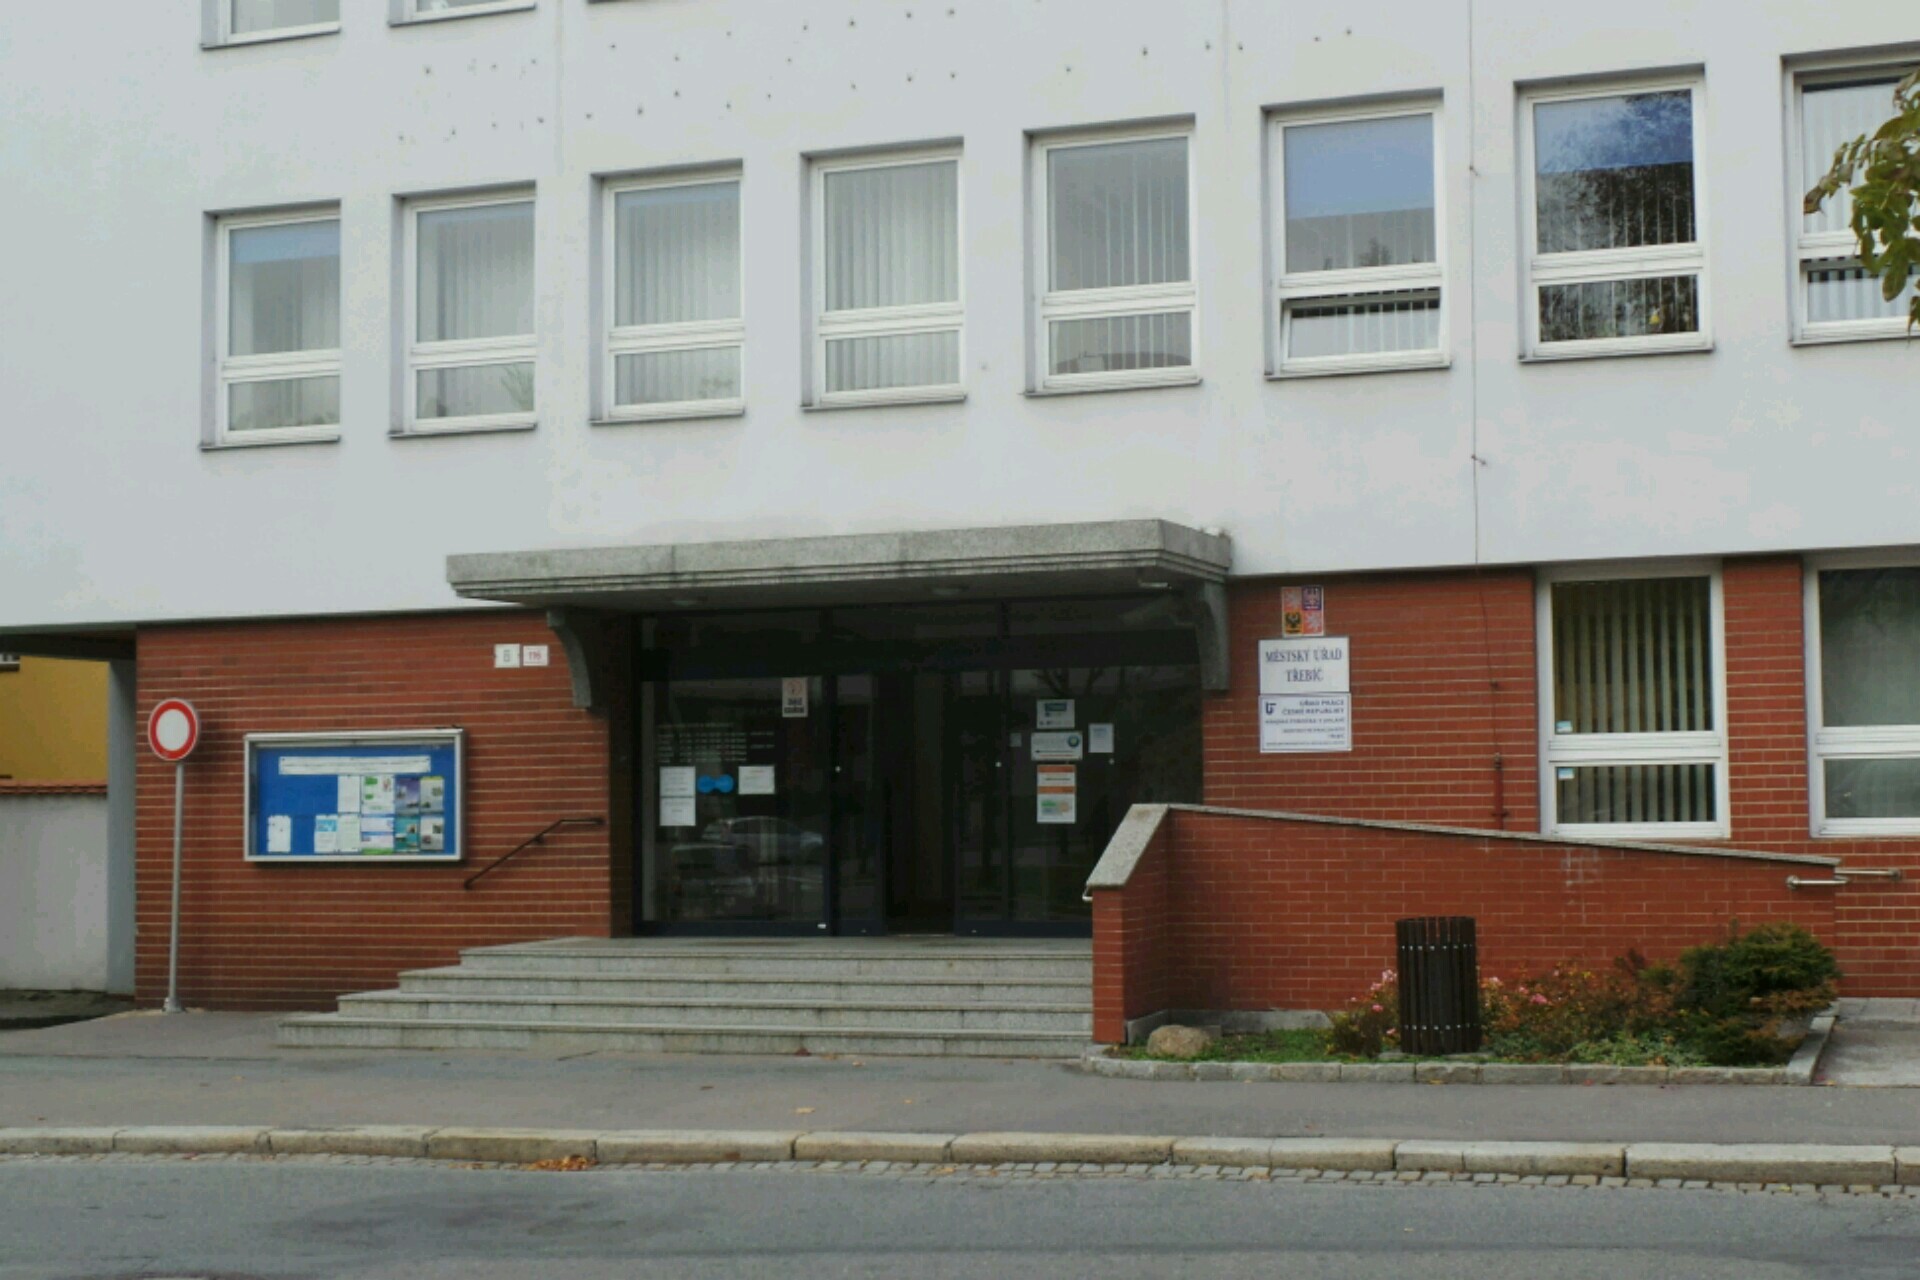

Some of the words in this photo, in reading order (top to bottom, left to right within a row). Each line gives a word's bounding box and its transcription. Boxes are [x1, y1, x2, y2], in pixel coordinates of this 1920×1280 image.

[1266, 647, 1310, 662] MĚSTSKÝ
[1313, 646, 1342, 660] ÚŘAD
[1286, 668, 1323, 682] TŘEBÍČ
